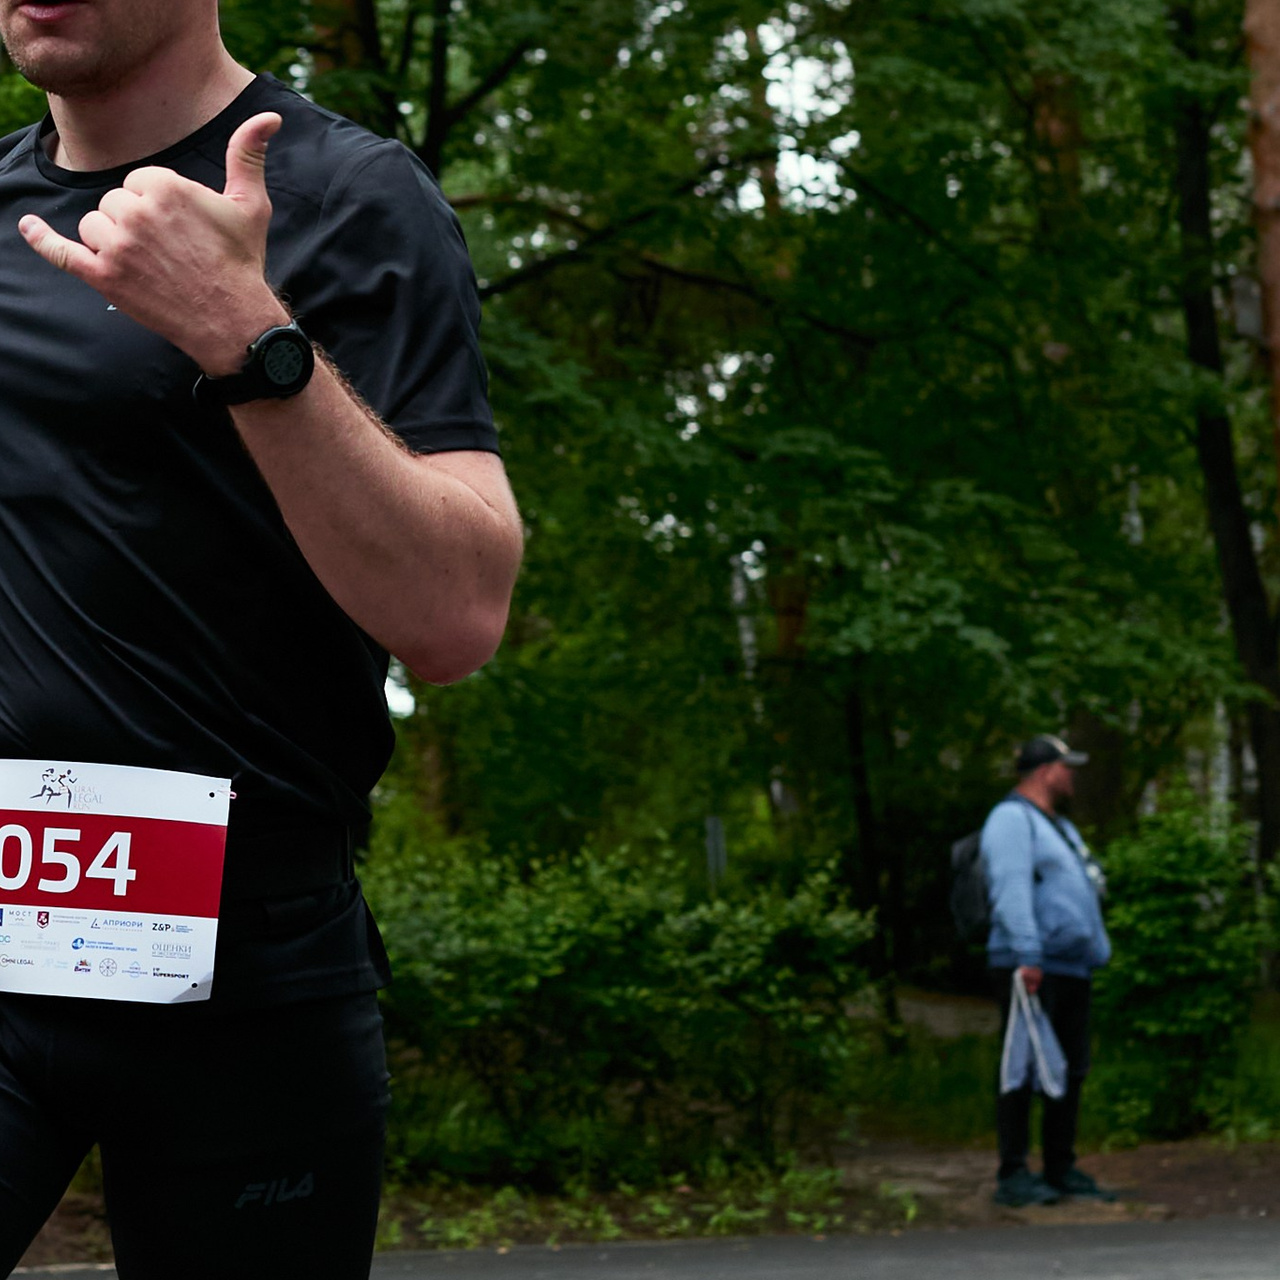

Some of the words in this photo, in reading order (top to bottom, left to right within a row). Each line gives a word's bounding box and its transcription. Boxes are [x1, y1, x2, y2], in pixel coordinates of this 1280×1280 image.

[73, 793, 104, 805] LEGAL
[102, 919, 143, 928] АПРИОРИ
[152, 923, 171, 932] Z&P
[151, 943, 192, 953] ОЦЕНКИ
[152, 972, 190, 980] SUPERSPORT
[234, 1171, 315, 1210] FILA
